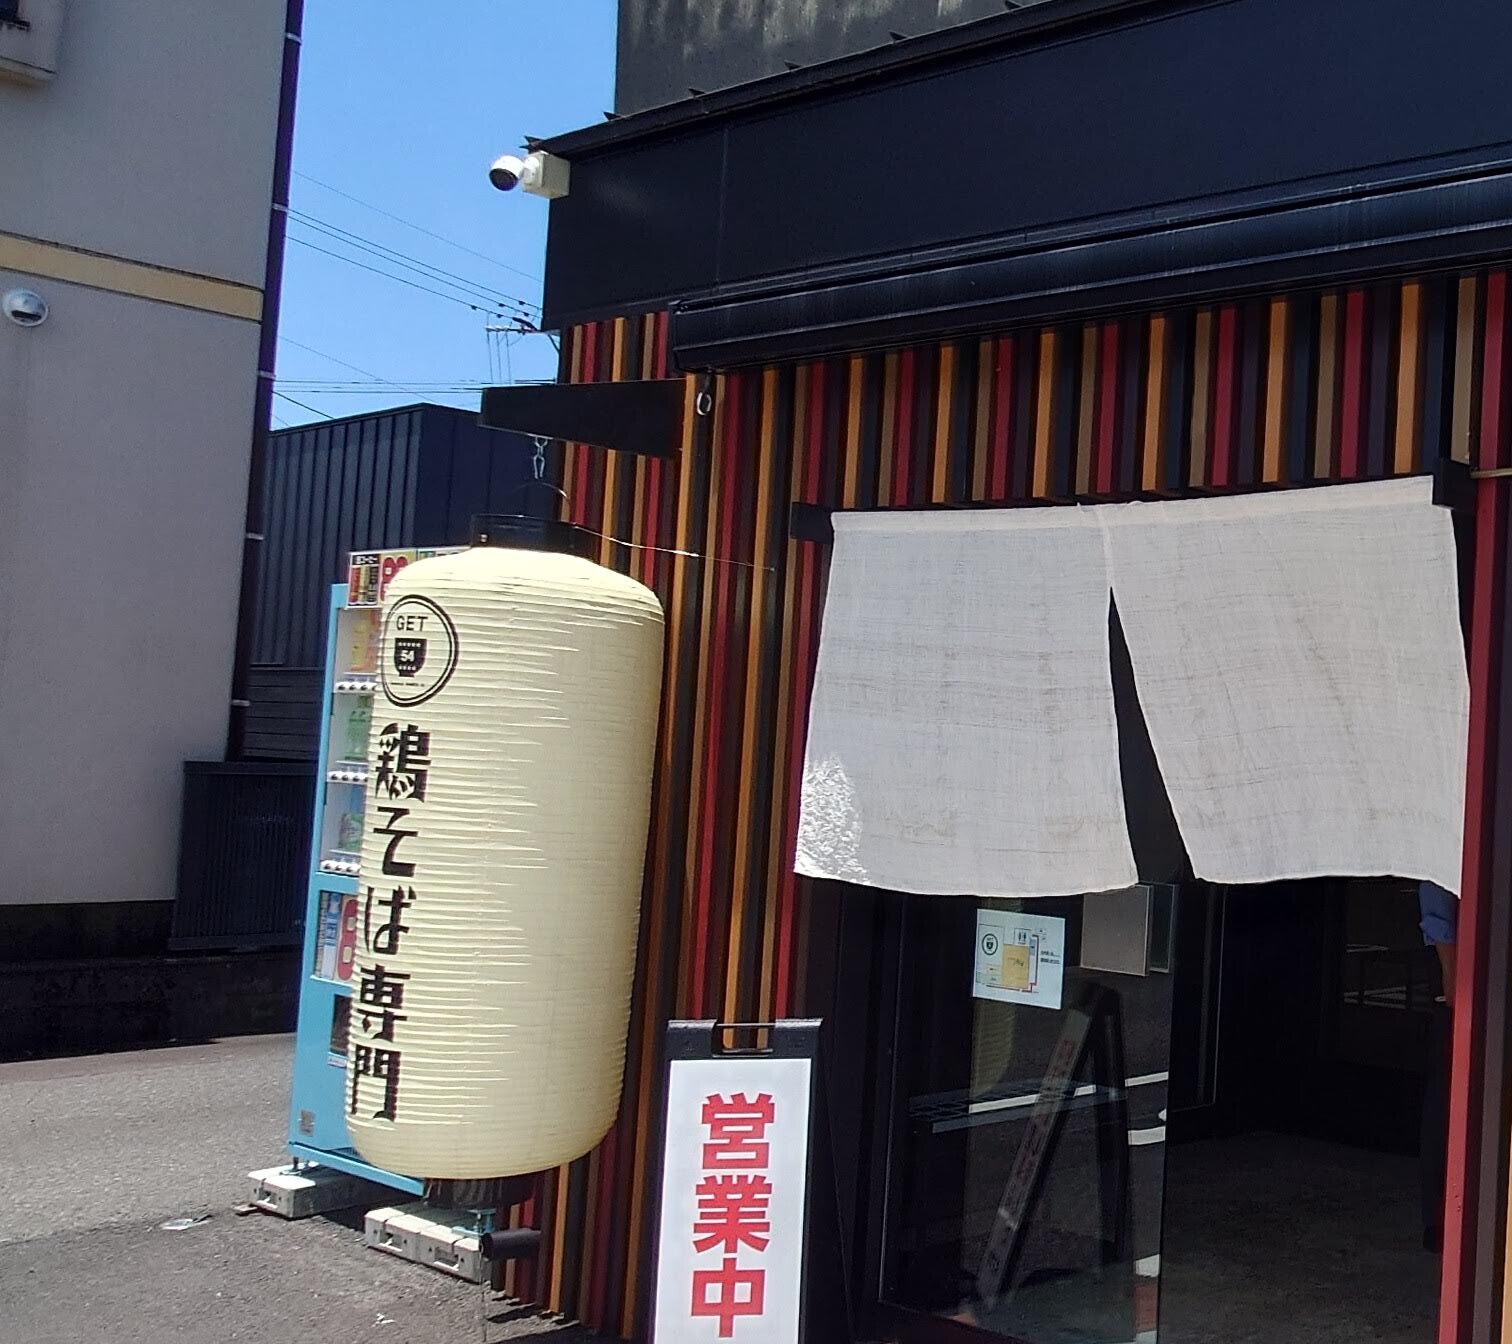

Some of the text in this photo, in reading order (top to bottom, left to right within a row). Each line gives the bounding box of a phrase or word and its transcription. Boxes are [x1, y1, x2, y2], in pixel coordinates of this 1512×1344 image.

[396, 616, 428, 631] GET
[400, 649, 415, 662] 54
[350, 722, 431, 1122] 鶏そば専門
[691, 1092, 776, 1338] 営業中
